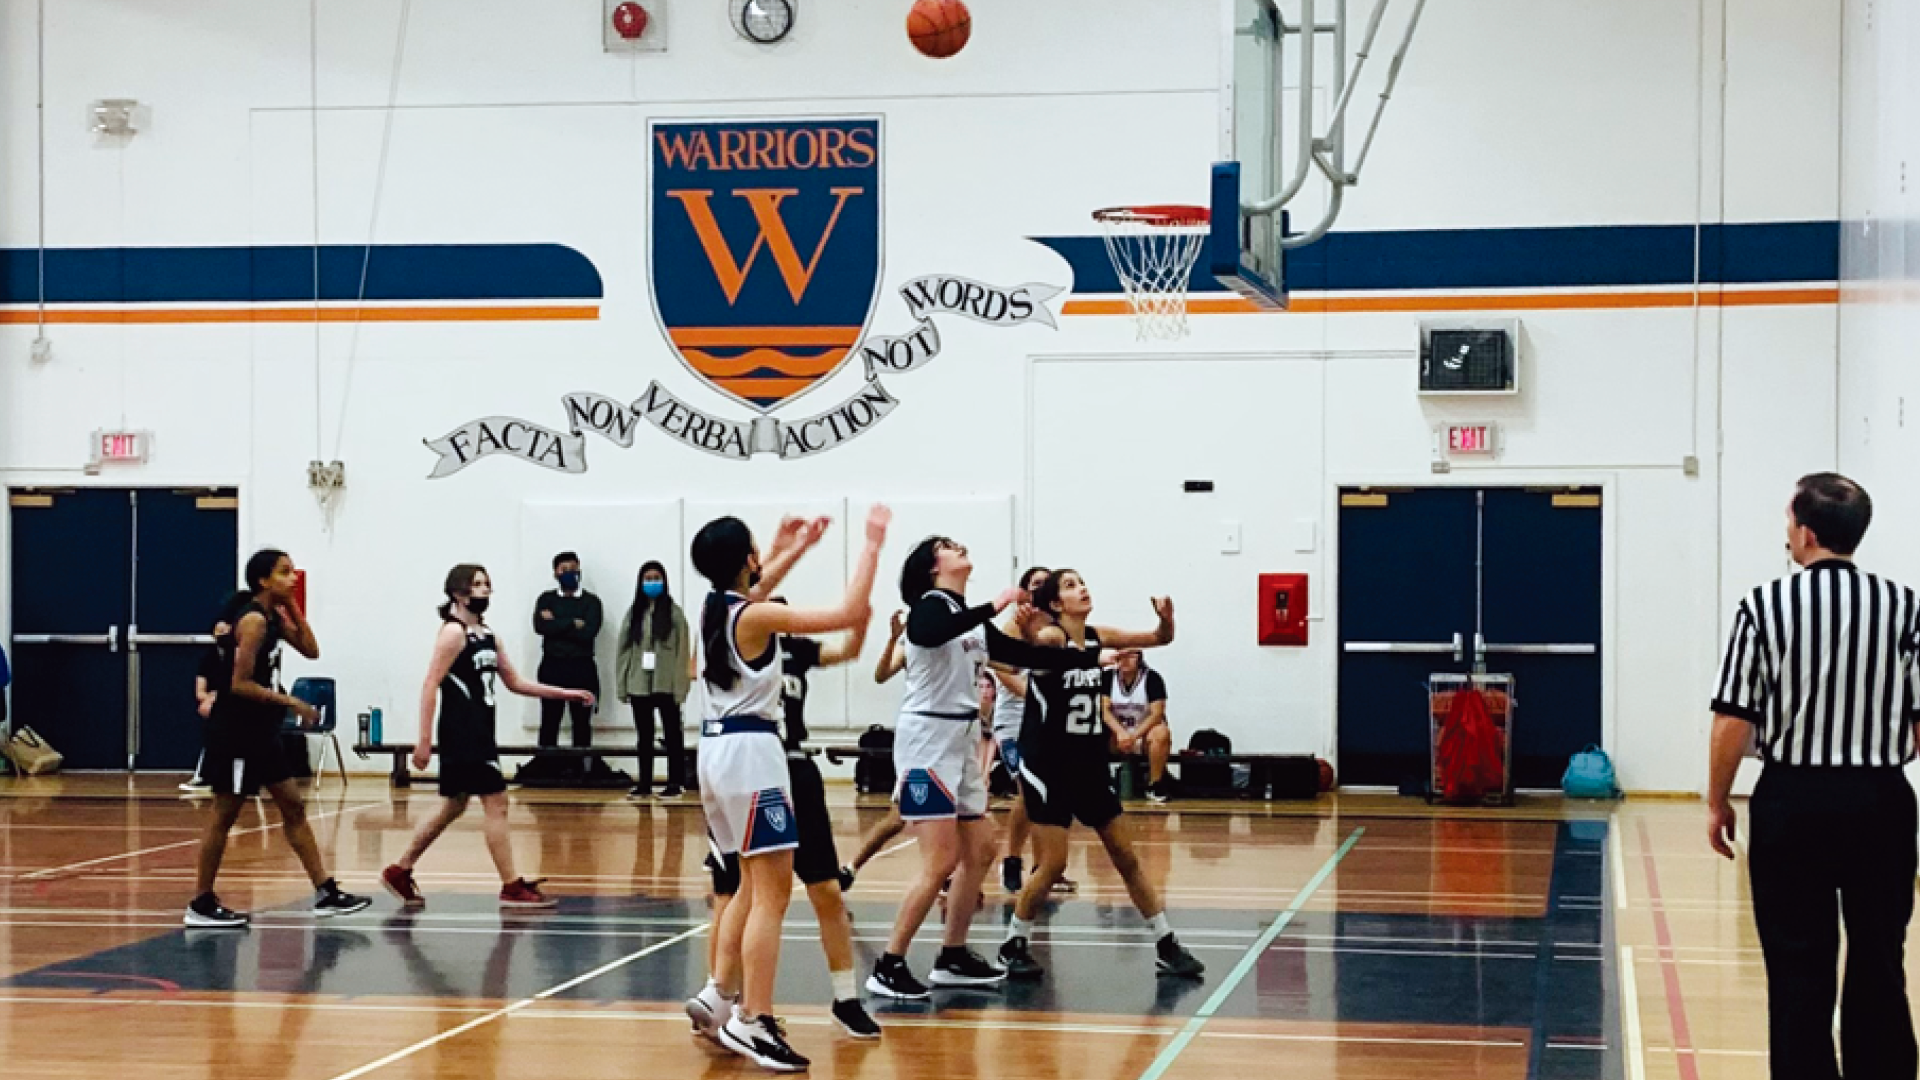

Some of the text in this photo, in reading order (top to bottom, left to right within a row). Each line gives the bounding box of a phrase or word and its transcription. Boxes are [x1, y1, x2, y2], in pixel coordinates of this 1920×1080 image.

[655, 128, 875, 171] WARRIORS
[665, 186, 864, 306] W
[449, 277, 1033, 468] FACTA NON VERBA ACTION NOT WORDS
[1448, 426, 1487, 449] EXIT
